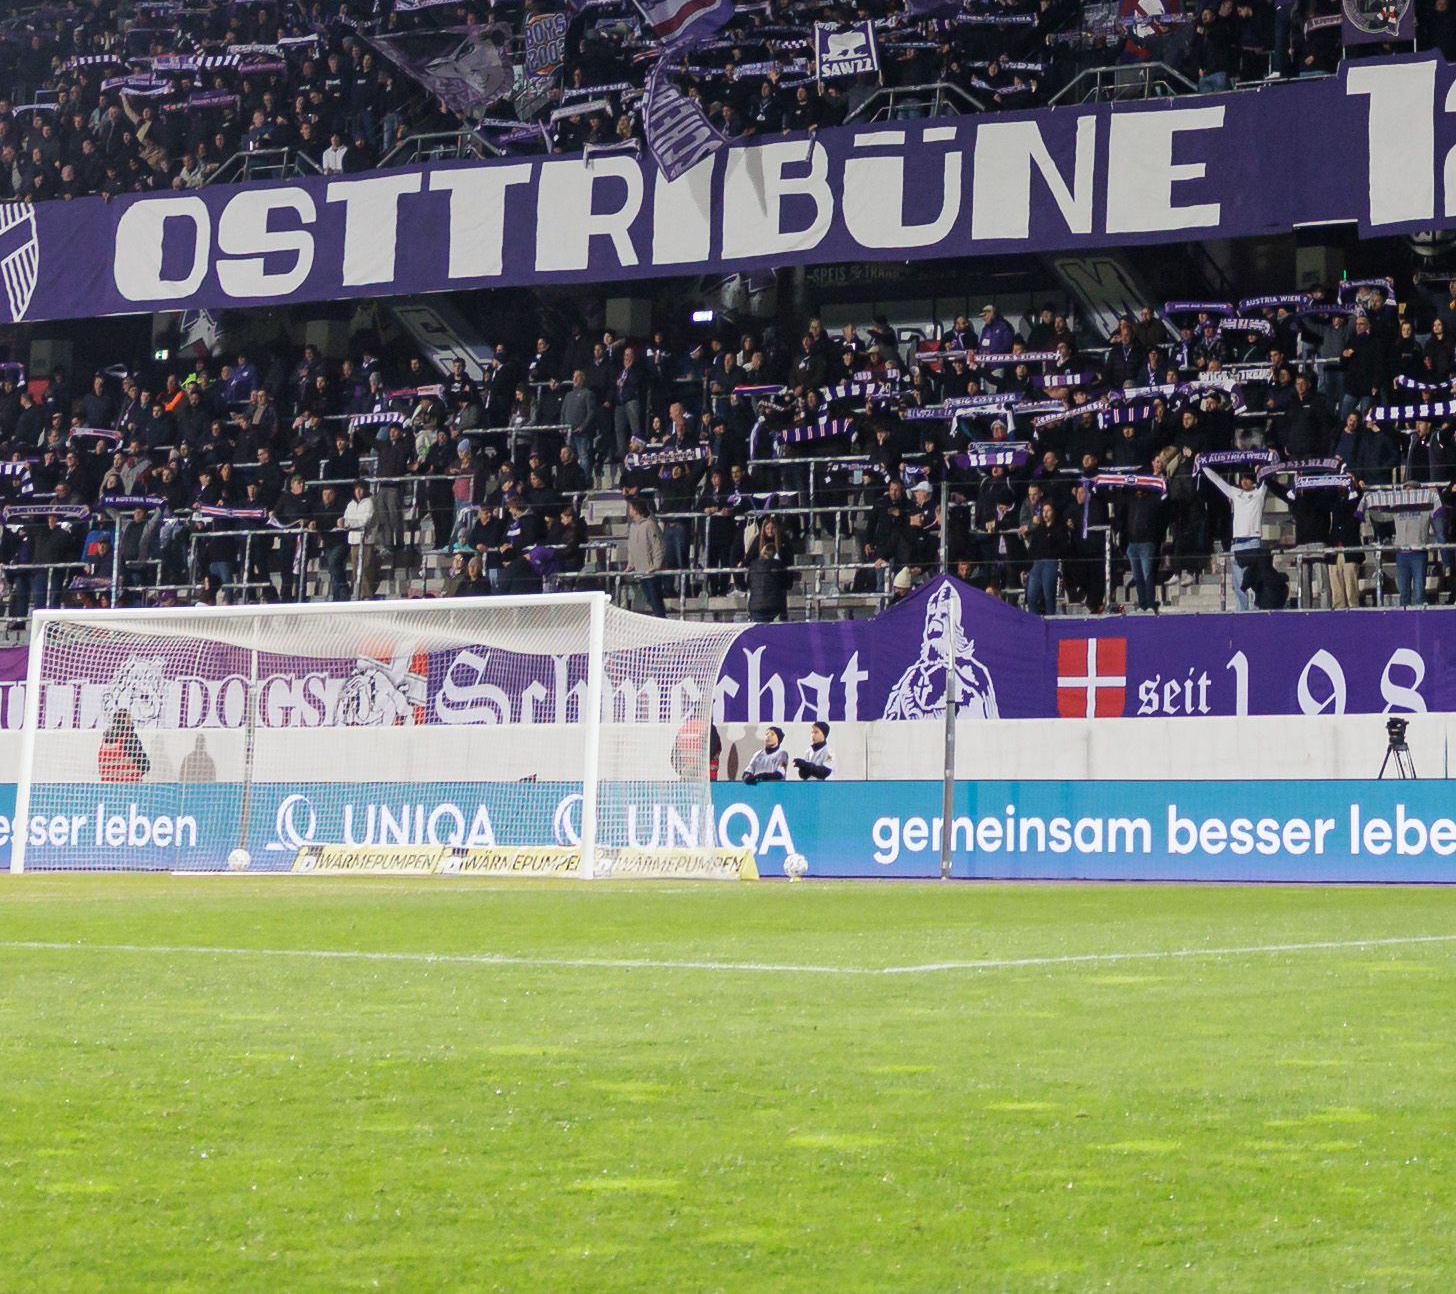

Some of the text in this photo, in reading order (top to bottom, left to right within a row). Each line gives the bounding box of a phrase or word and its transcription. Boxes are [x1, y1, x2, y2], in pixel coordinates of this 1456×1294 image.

[114, 105, 1226, 301] OSTTRIBÜNE
[1245, 296, 1280, 308] AUSTRIA
[1281, 293, 1302, 304] WIEN
[177, 671, 331, 729] DOGS
[1138, 667, 1212, 715] seit
[95, 803, 197, 848] leben
[344, 803, 497, 848] UNIQA
[627, 803, 796, 857] UNIQA
[872, 806, 1152, 866] gemeinsam
[1166, 805, 1335, 857] besser
[318, 849, 435, 871] WÄRMEPUMPEN
